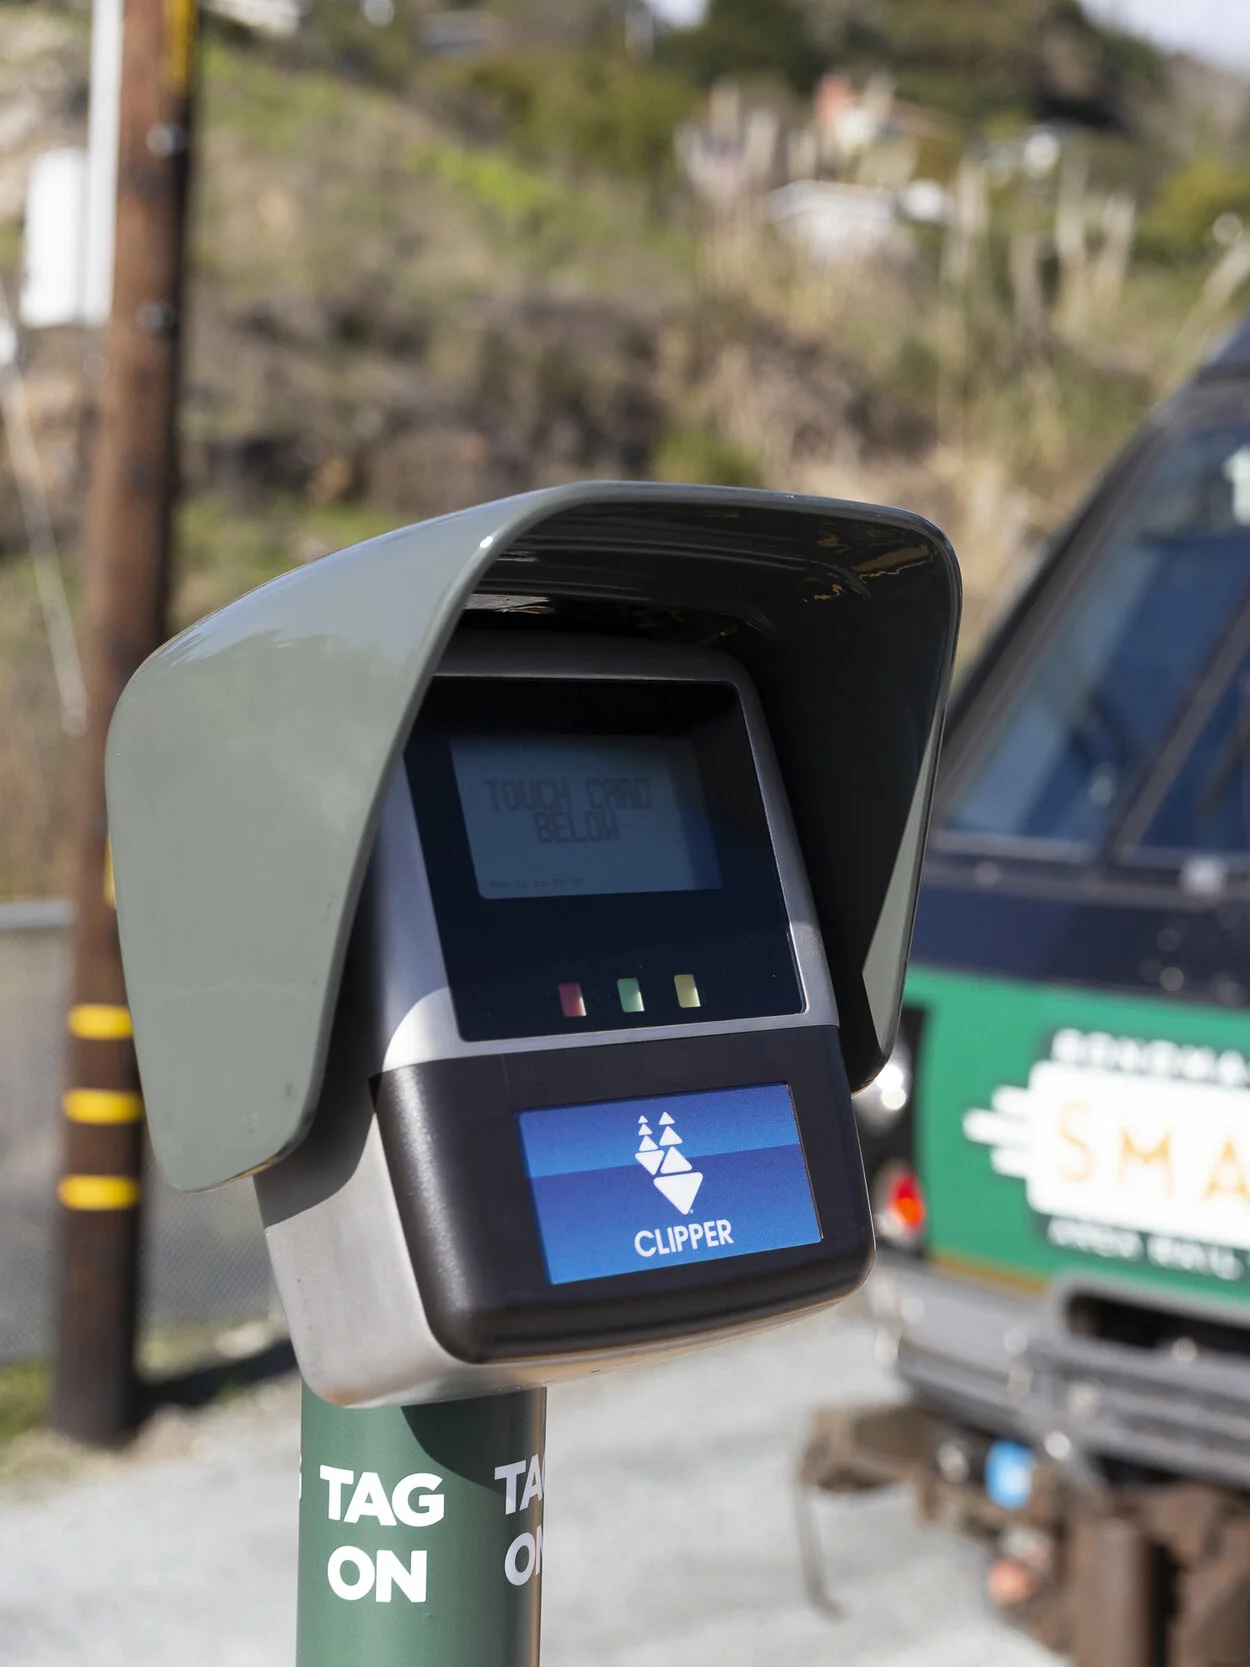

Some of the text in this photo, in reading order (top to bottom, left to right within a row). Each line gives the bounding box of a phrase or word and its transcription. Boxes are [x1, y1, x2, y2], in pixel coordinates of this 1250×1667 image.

[483, 776, 655, 813] TOUCH CARD
[533, 809, 622, 845] BELOW
[633, 1218, 735, 1258] CLIPPER
[319, 1464, 445, 1528] TAG
[494, 1453, 545, 1516] TA
[327, 1545, 428, 1603] ON
